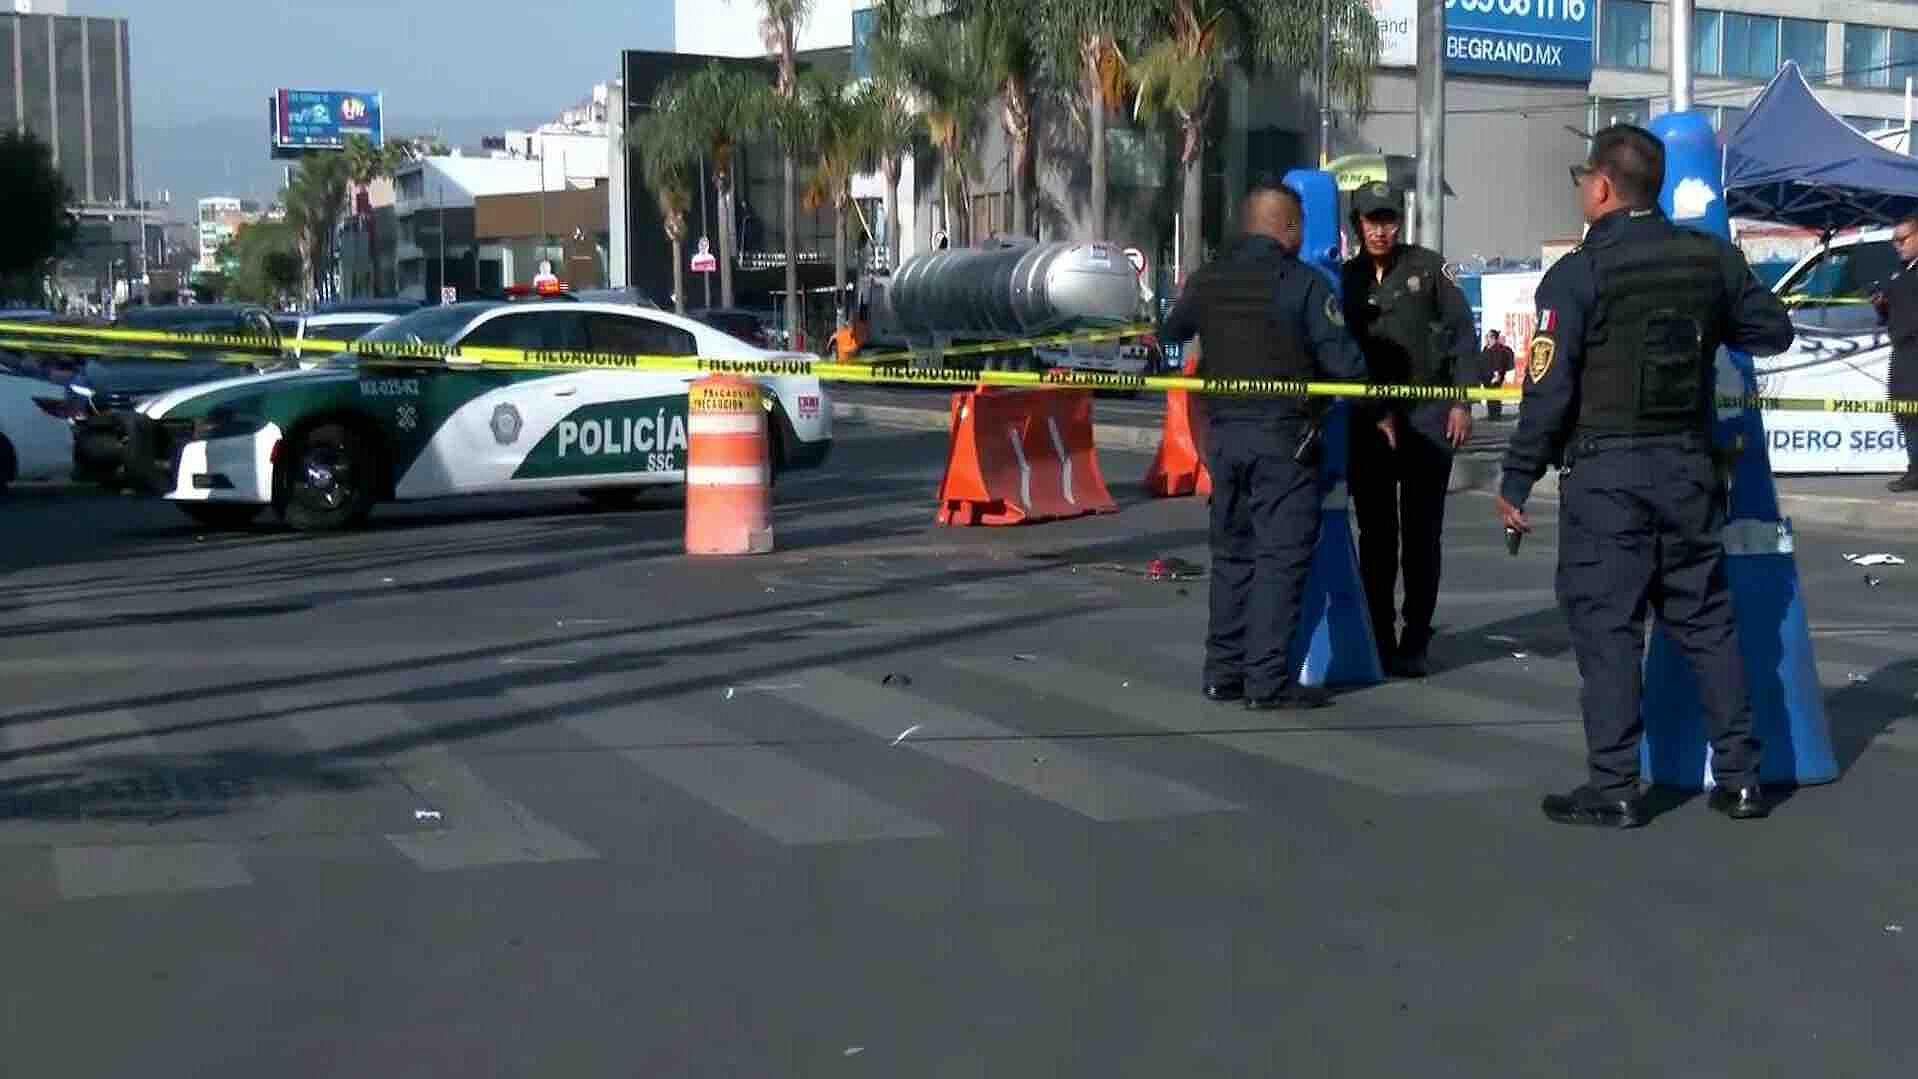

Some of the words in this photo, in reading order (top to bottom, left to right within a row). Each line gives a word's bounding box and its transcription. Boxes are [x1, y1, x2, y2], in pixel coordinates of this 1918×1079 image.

[1446, 36, 1562, 65] BEGRAND.MX
[523, 350, 637, 367] PRECAUCION
[697, 359, 812, 375] PRECAUCION
[558, 407, 688, 457] POLICÍA
[648, 453, 675, 472] SSC
